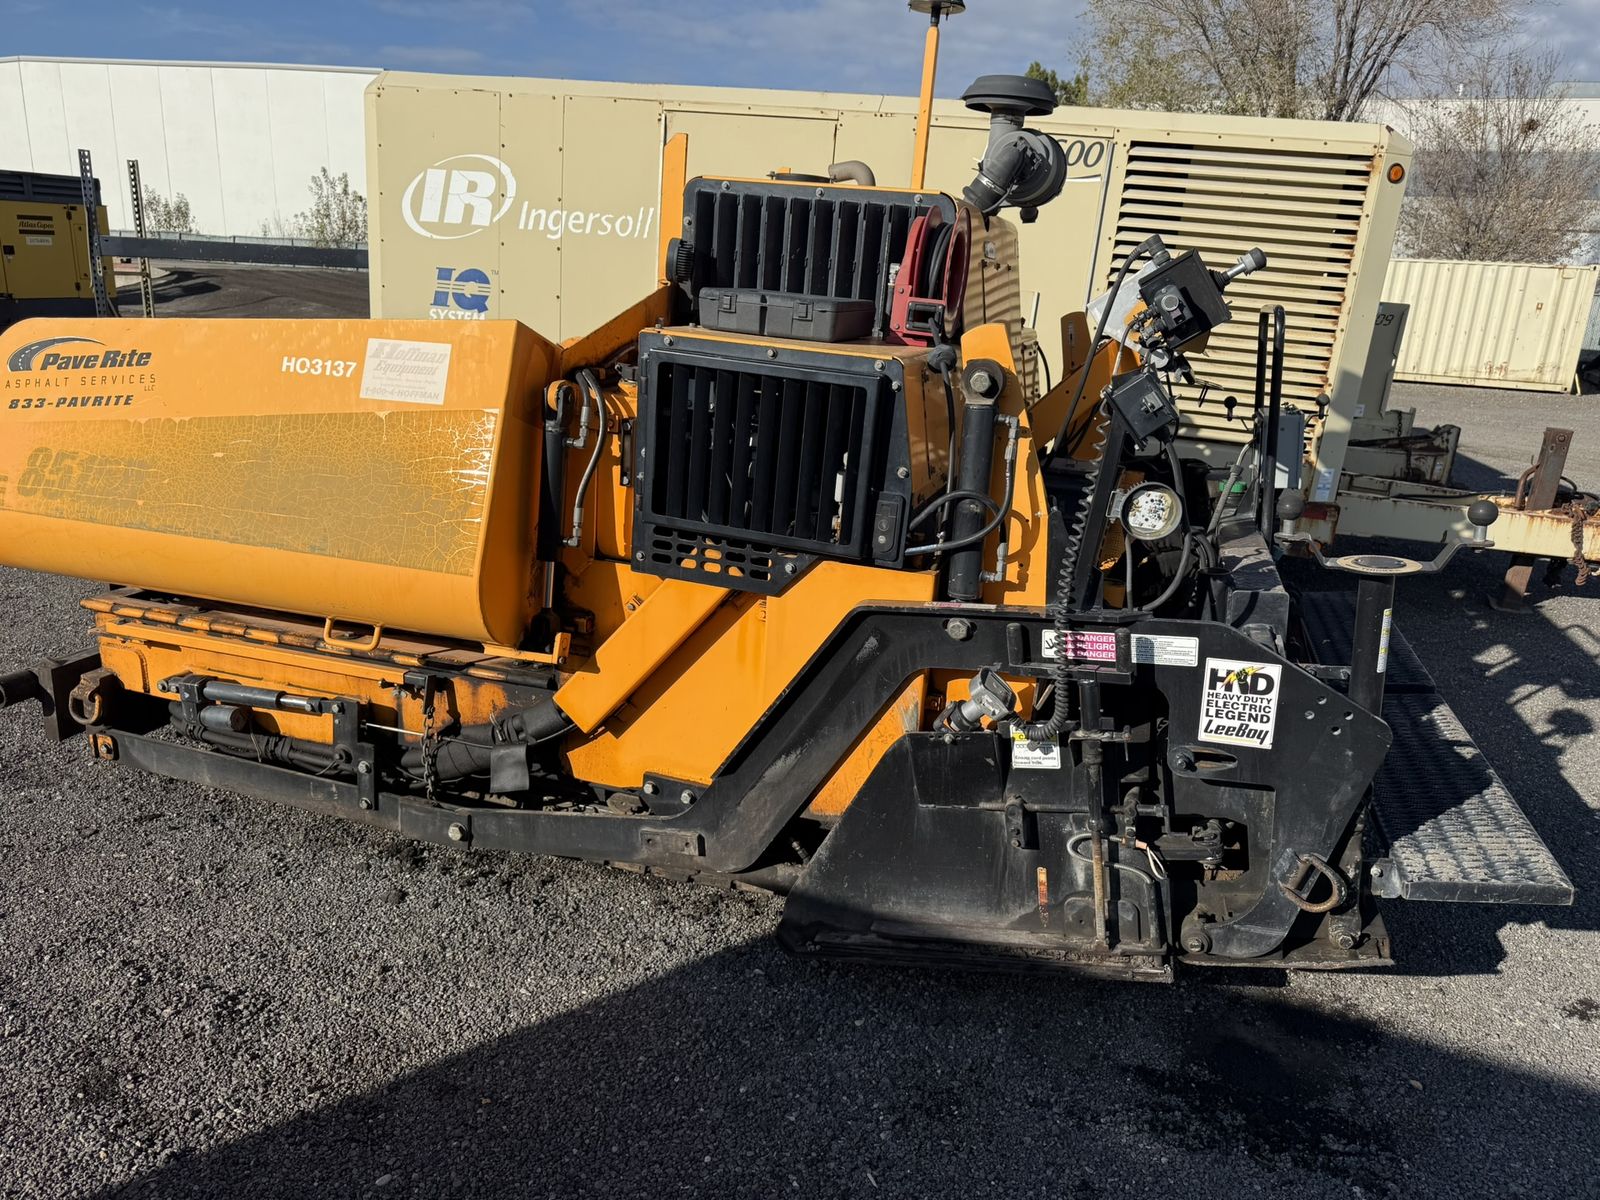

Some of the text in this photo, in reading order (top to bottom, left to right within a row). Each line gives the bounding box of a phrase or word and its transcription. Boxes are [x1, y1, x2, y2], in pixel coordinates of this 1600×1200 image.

[419, 168, 496, 227] IR
[518, 201, 655, 240] Ingersoll
[430, 267, 491, 313] IQ
[40, 349, 152, 371] Pave Rite
[5, 374, 156, 389] ASPHALT SERVICES
[8, 395, 134, 409] 833-PAVRITE
[1077, 634, 1115, 642] DANGER
[1076, 642, 1116, 650] PELIGRO
[1077, 650, 1116, 658] DANGER
[1207, 691, 1272, 704] HEAVY DUTY
[1206, 699, 1271, 714] ELECTRIC
[1205, 708, 1270, 724] LEGEND
[1203, 719, 1269, 745] LeeBoy
